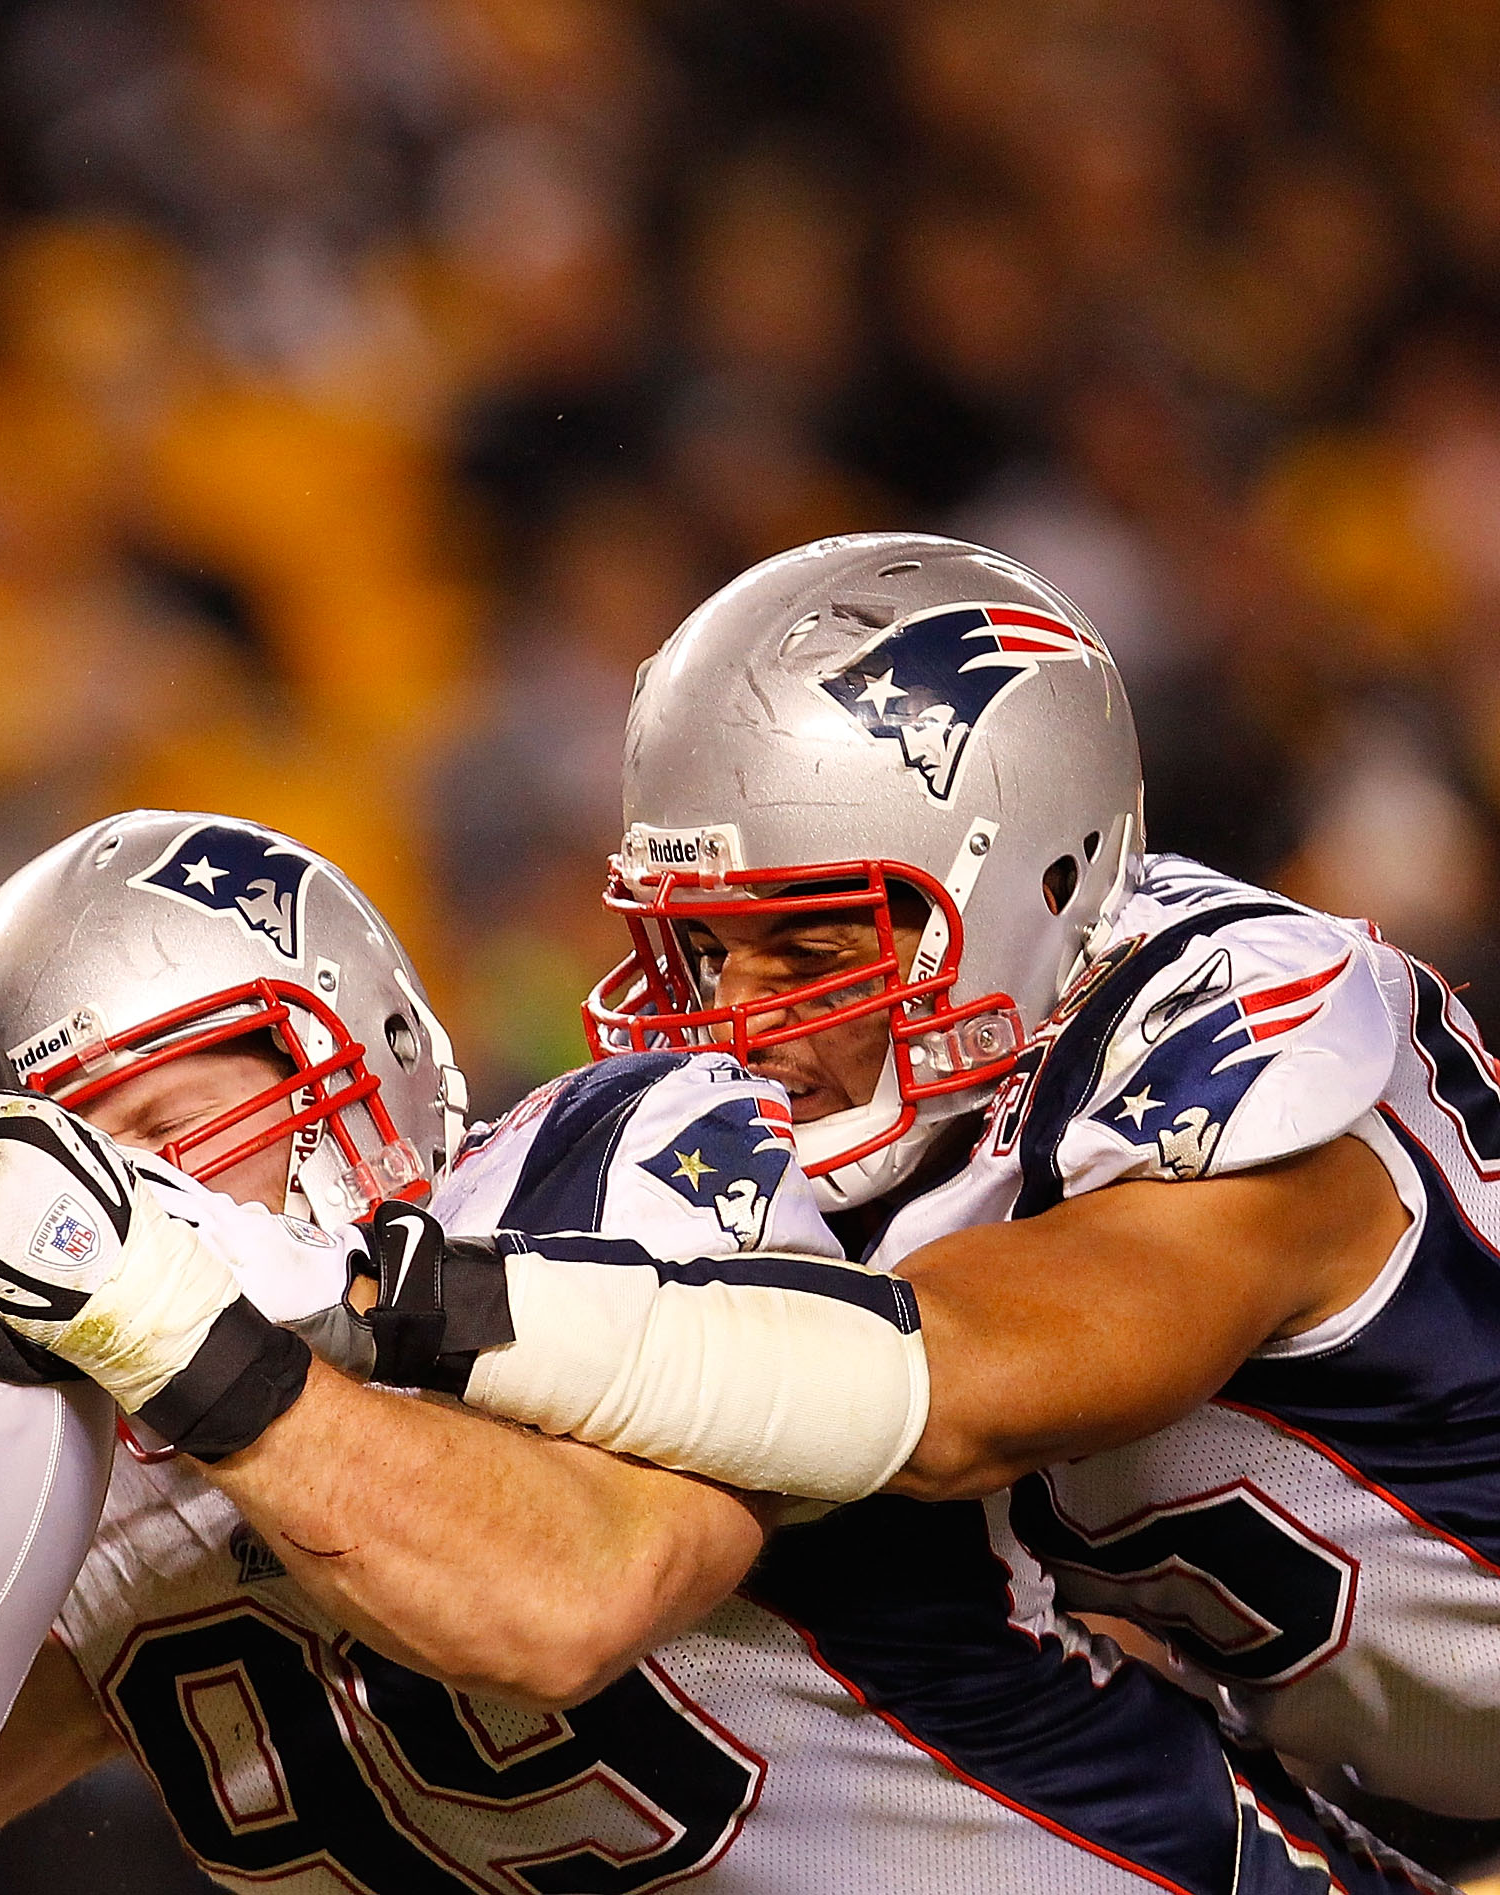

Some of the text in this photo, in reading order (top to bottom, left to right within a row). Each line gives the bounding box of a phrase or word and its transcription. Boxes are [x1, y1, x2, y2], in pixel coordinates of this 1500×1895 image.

[648, 836, 701, 863] Riddel
[34, 1199, 72, 1254] EQUIPMENT
[65, 1230, 93, 1258] NFL
